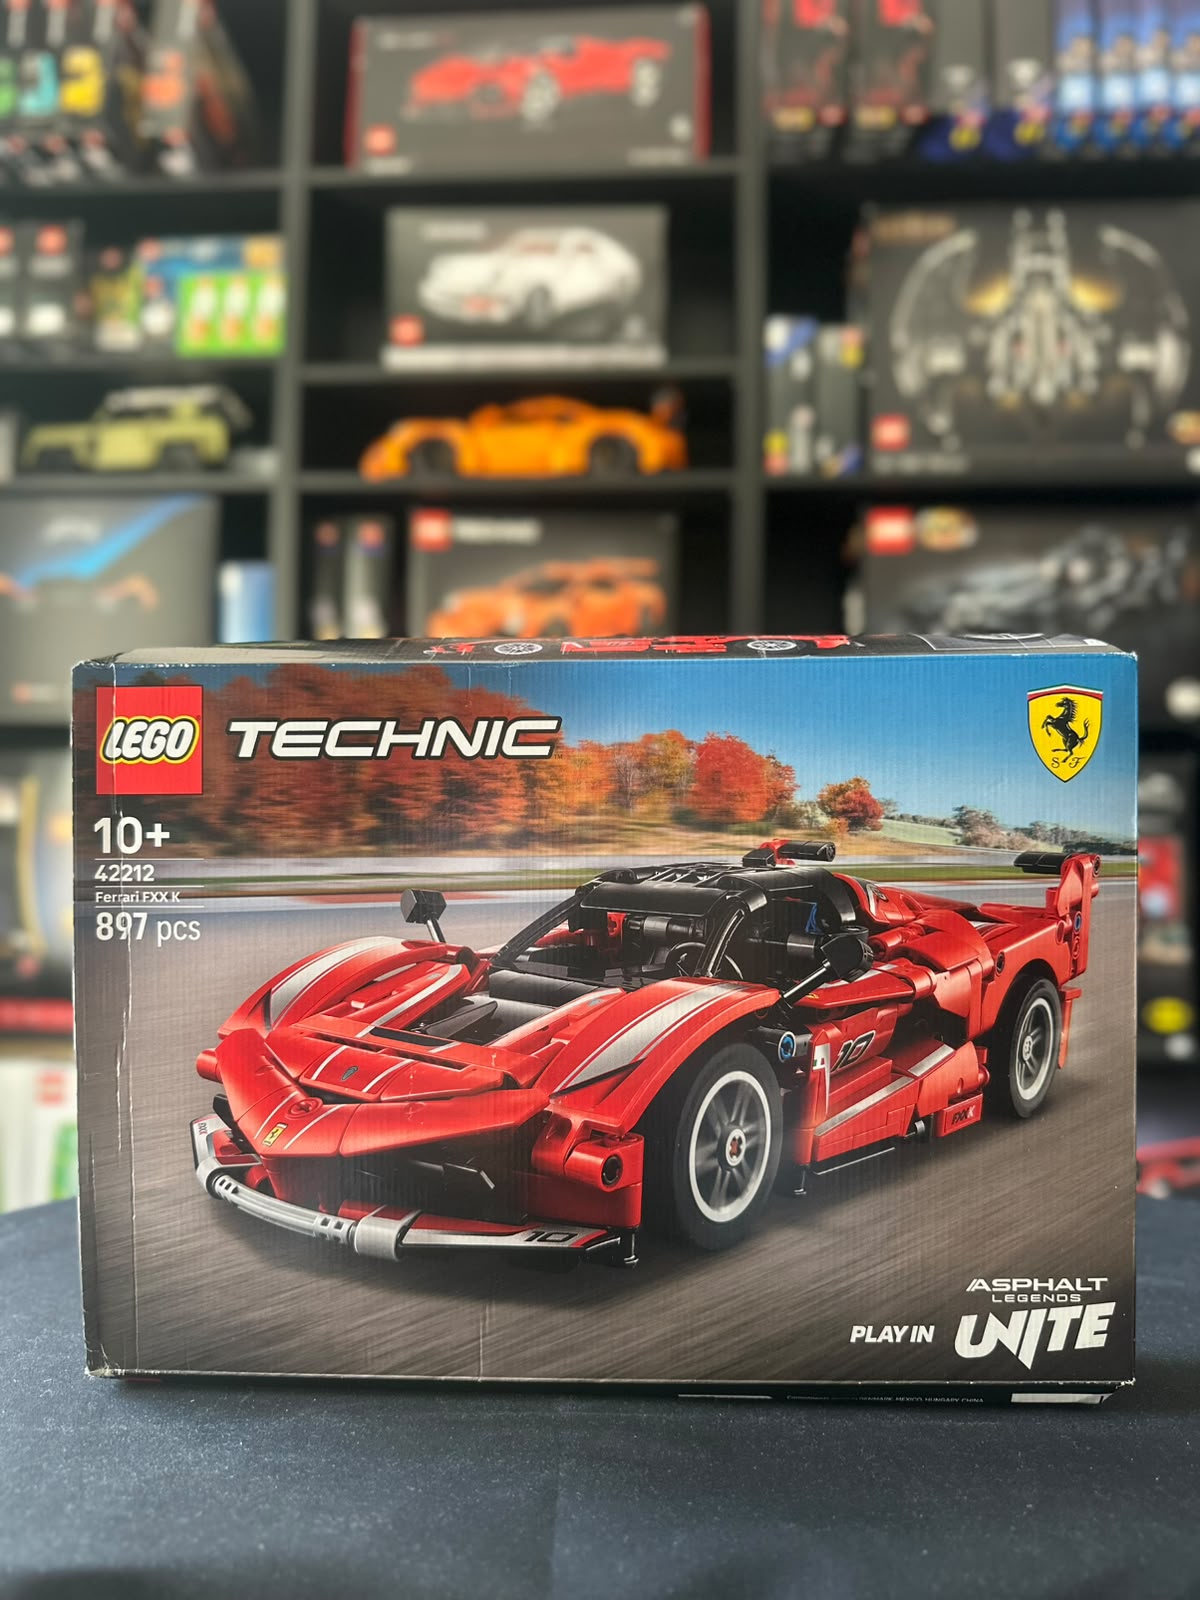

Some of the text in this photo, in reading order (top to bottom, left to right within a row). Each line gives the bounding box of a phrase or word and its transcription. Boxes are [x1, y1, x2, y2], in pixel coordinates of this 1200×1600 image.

[101, 717, 199, 763] LEGO
[228, 718, 562, 759] TECHNIC
[94, 816, 171, 855] 10+
[94, 863, 156, 882] 42212
[95, 890, 181, 903] Ferrari FXX K
[96, 911, 201, 947] 897 pcs
[524, 1230, 579, 1243] 10
[966, 1277, 1109, 1292] ASPHALT
[991, 1293, 1082, 1304] LEGENDS
[849, 1324, 935, 1344] PLAY IN
[954, 1301, 1117, 1370] UNITE
